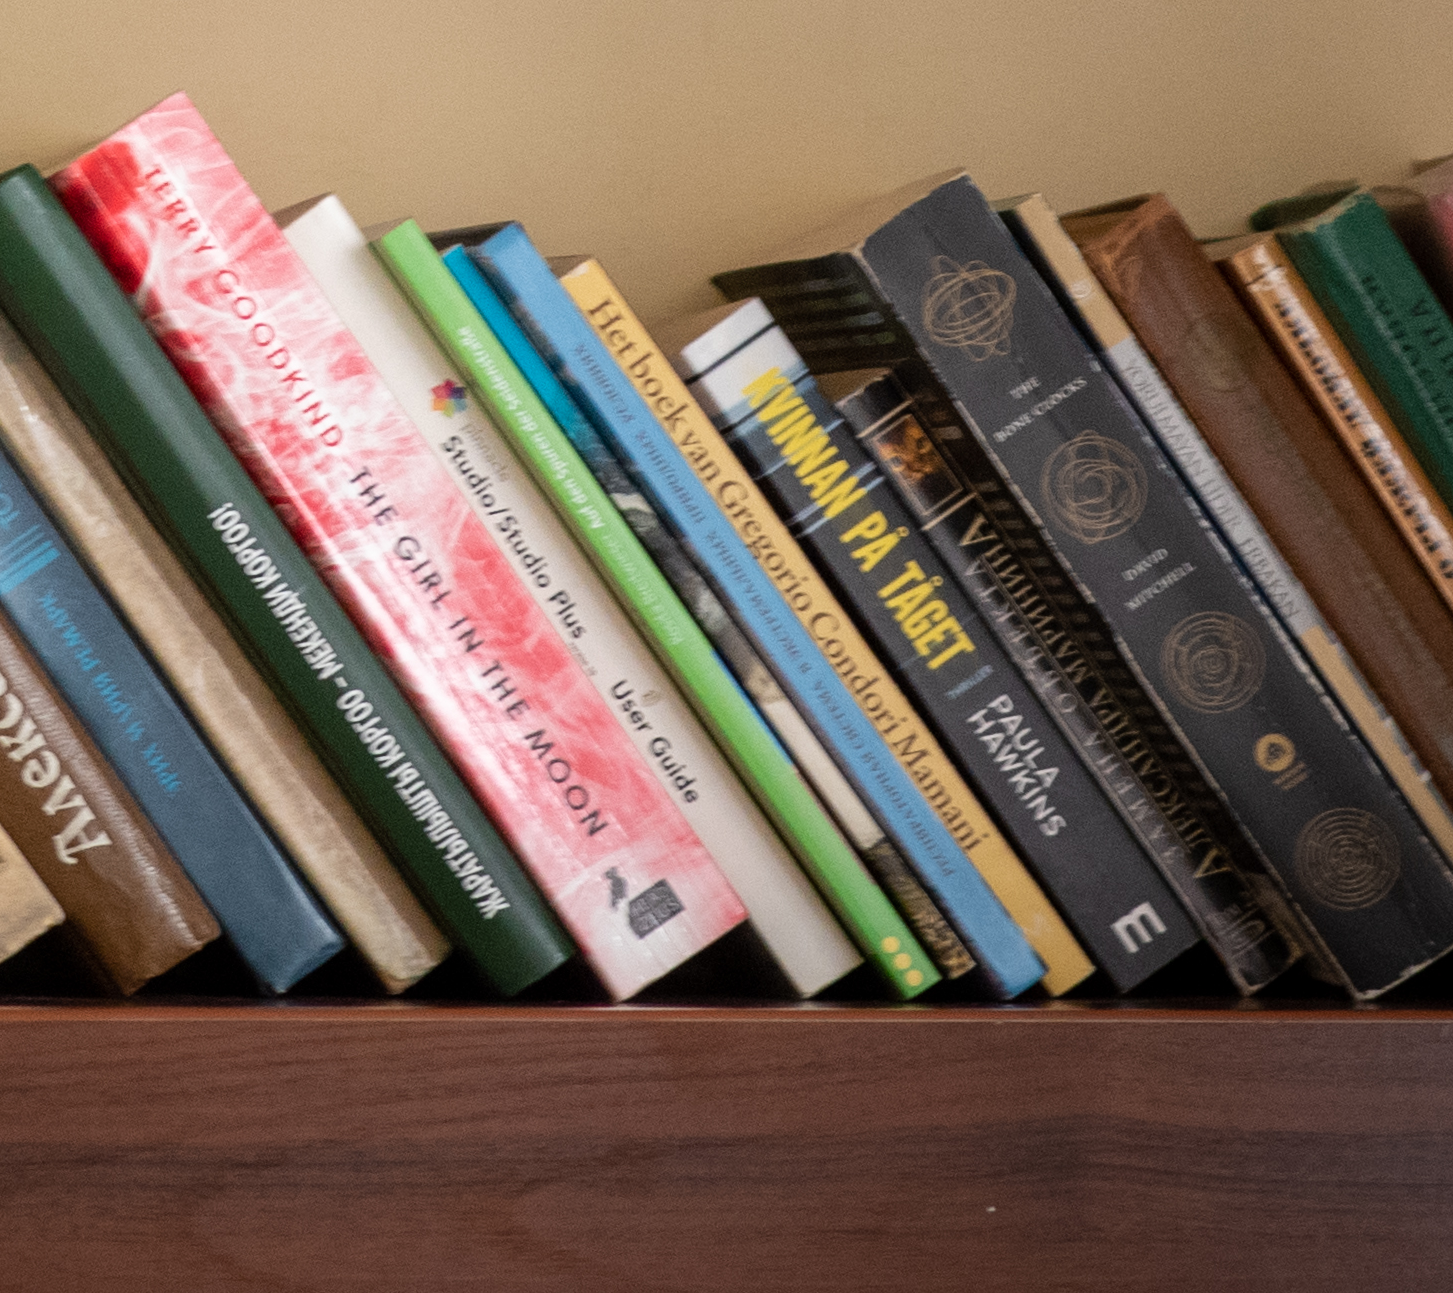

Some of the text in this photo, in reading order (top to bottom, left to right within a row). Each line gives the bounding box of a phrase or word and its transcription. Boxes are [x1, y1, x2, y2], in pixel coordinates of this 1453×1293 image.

[137, 161, 610, 839] TERRY GOODKIND THE GIRL IN THE MOON
[737, 364, 869, 520] KVINNAN
[439, 431, 595, 643] Studio/Studio Plus
[583, 293, 643, 361] Het
[625, 353, 696, 435] boek
[676, 429, 725, 485] van
[706, 474, 823, 619] Gregorio
[803, 605, 909, 737] Condori
[889, 728, 991, 854] Mamani
[836, 500, 914, 574] PÅ
[872, 551, 986, 676] TÅGET
[205, 497, 511, 922] ЖАРАТЫЛЫШТЫ КОРГОО МЕКЕНДИ КОРГОО!
[606, 676, 656, 734] User
[645, 732, 706, 806] Guide
[965, 707, 1069, 839] HAWKINS
[985, 693, 1064, 789] PAULA
